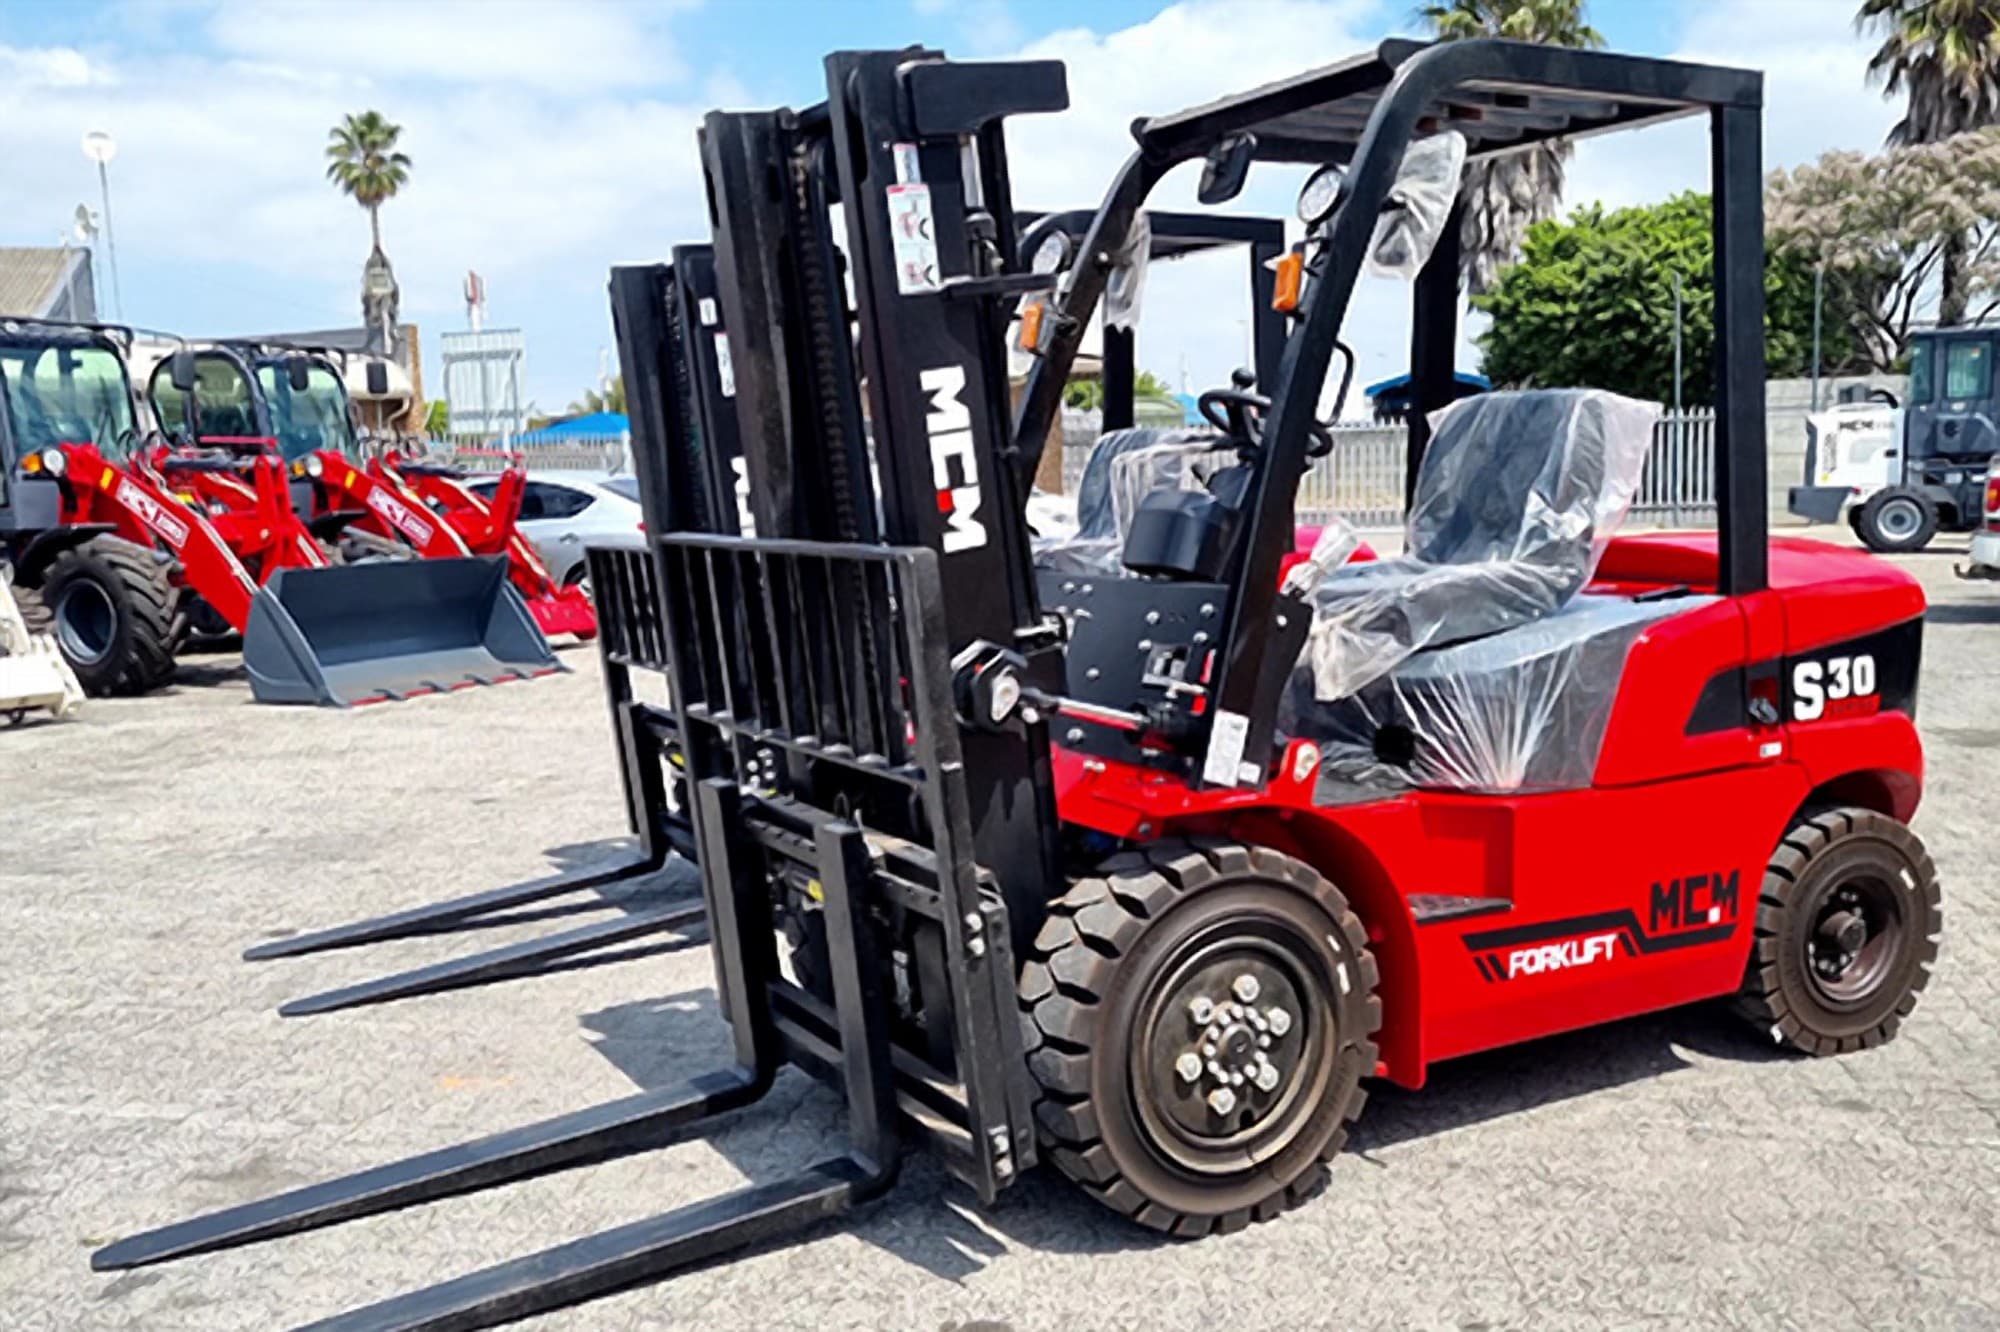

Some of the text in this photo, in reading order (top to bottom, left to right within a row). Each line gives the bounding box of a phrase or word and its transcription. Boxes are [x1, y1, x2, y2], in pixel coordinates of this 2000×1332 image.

[920, 365, 987, 553] MCM
[1793, 654, 1875, 721] S30
[1652, 869, 1740, 931] MCM
[1509, 933, 1618, 979] FORKLIFT
